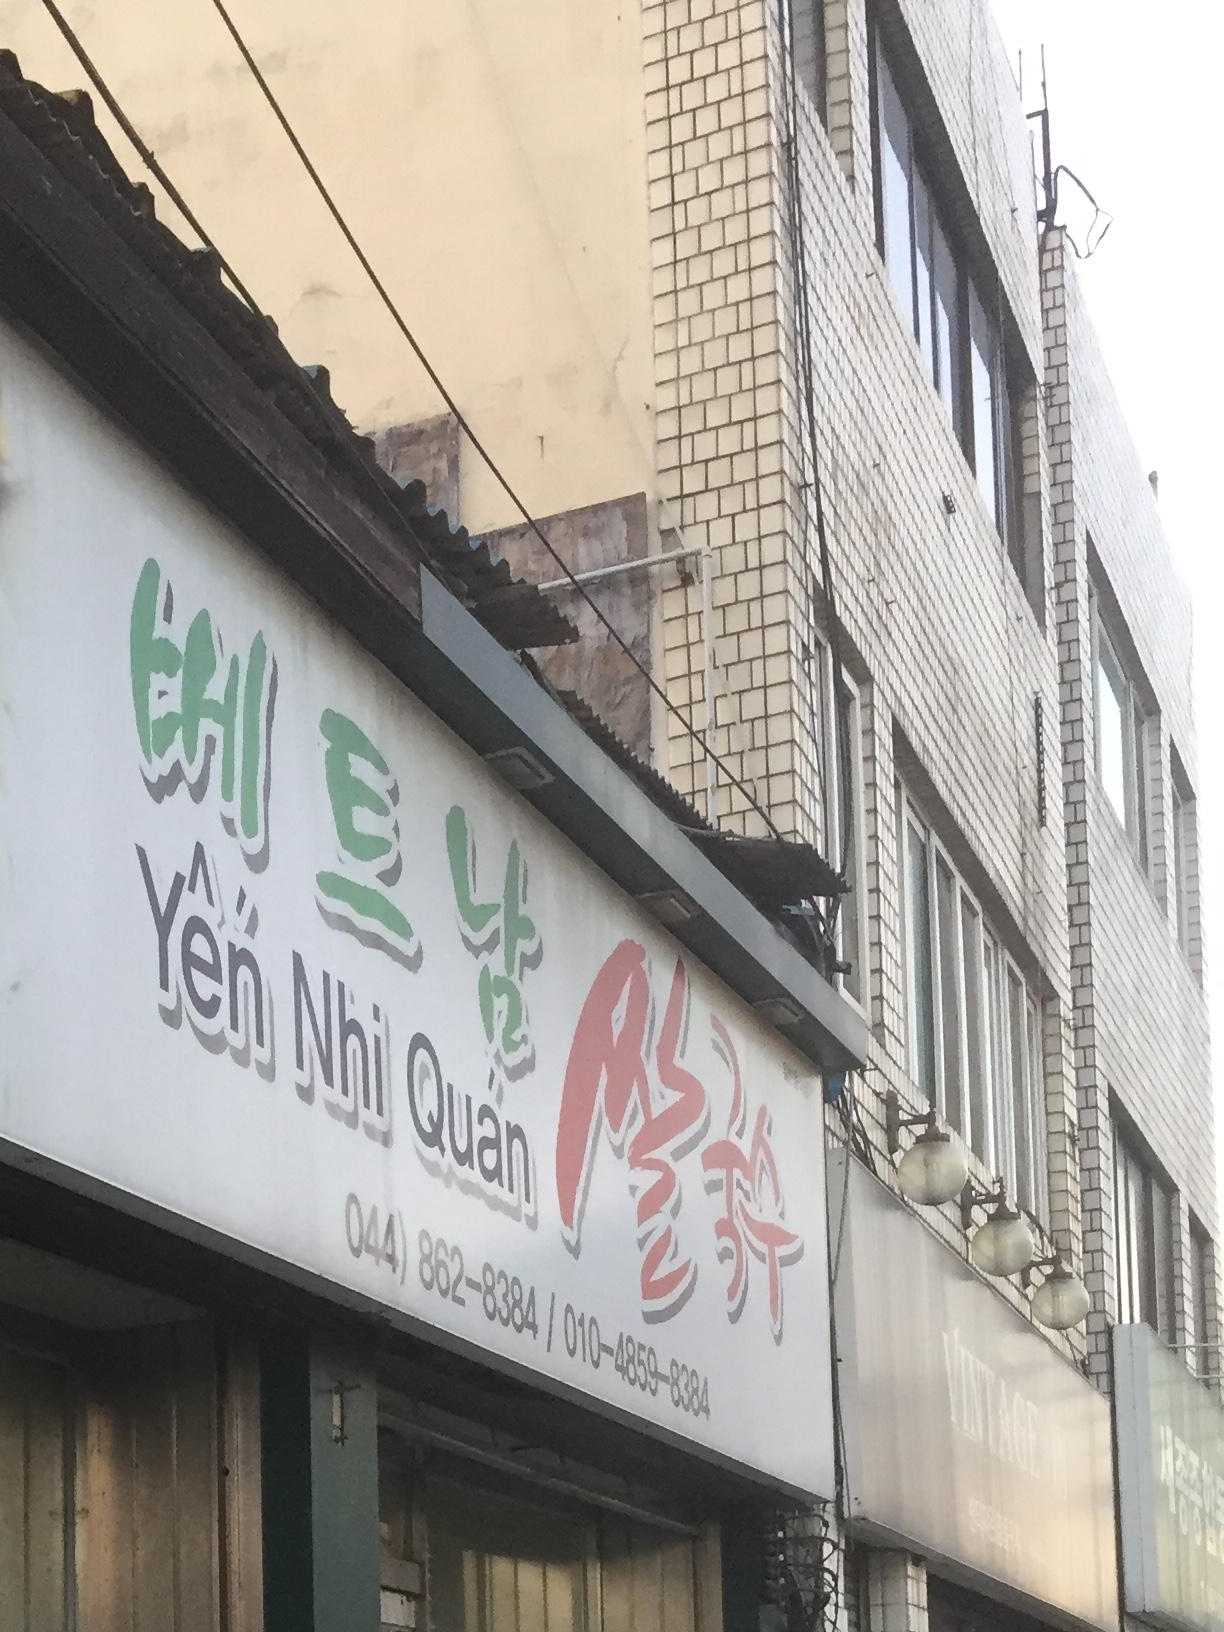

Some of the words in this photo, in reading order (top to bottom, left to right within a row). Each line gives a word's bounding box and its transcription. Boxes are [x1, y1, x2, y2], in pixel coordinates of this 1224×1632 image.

[130, 558, 541, 1055] 베트남
[292, 950, 383, 1118] Nhi
[556, 938, 799, 1325] 쌀국수
[345, 1194, 408, 1286] 044)
[418, 1228, 539, 1339] 862-8384
[564, 1303, 711, 1418] 010-4859-8384
